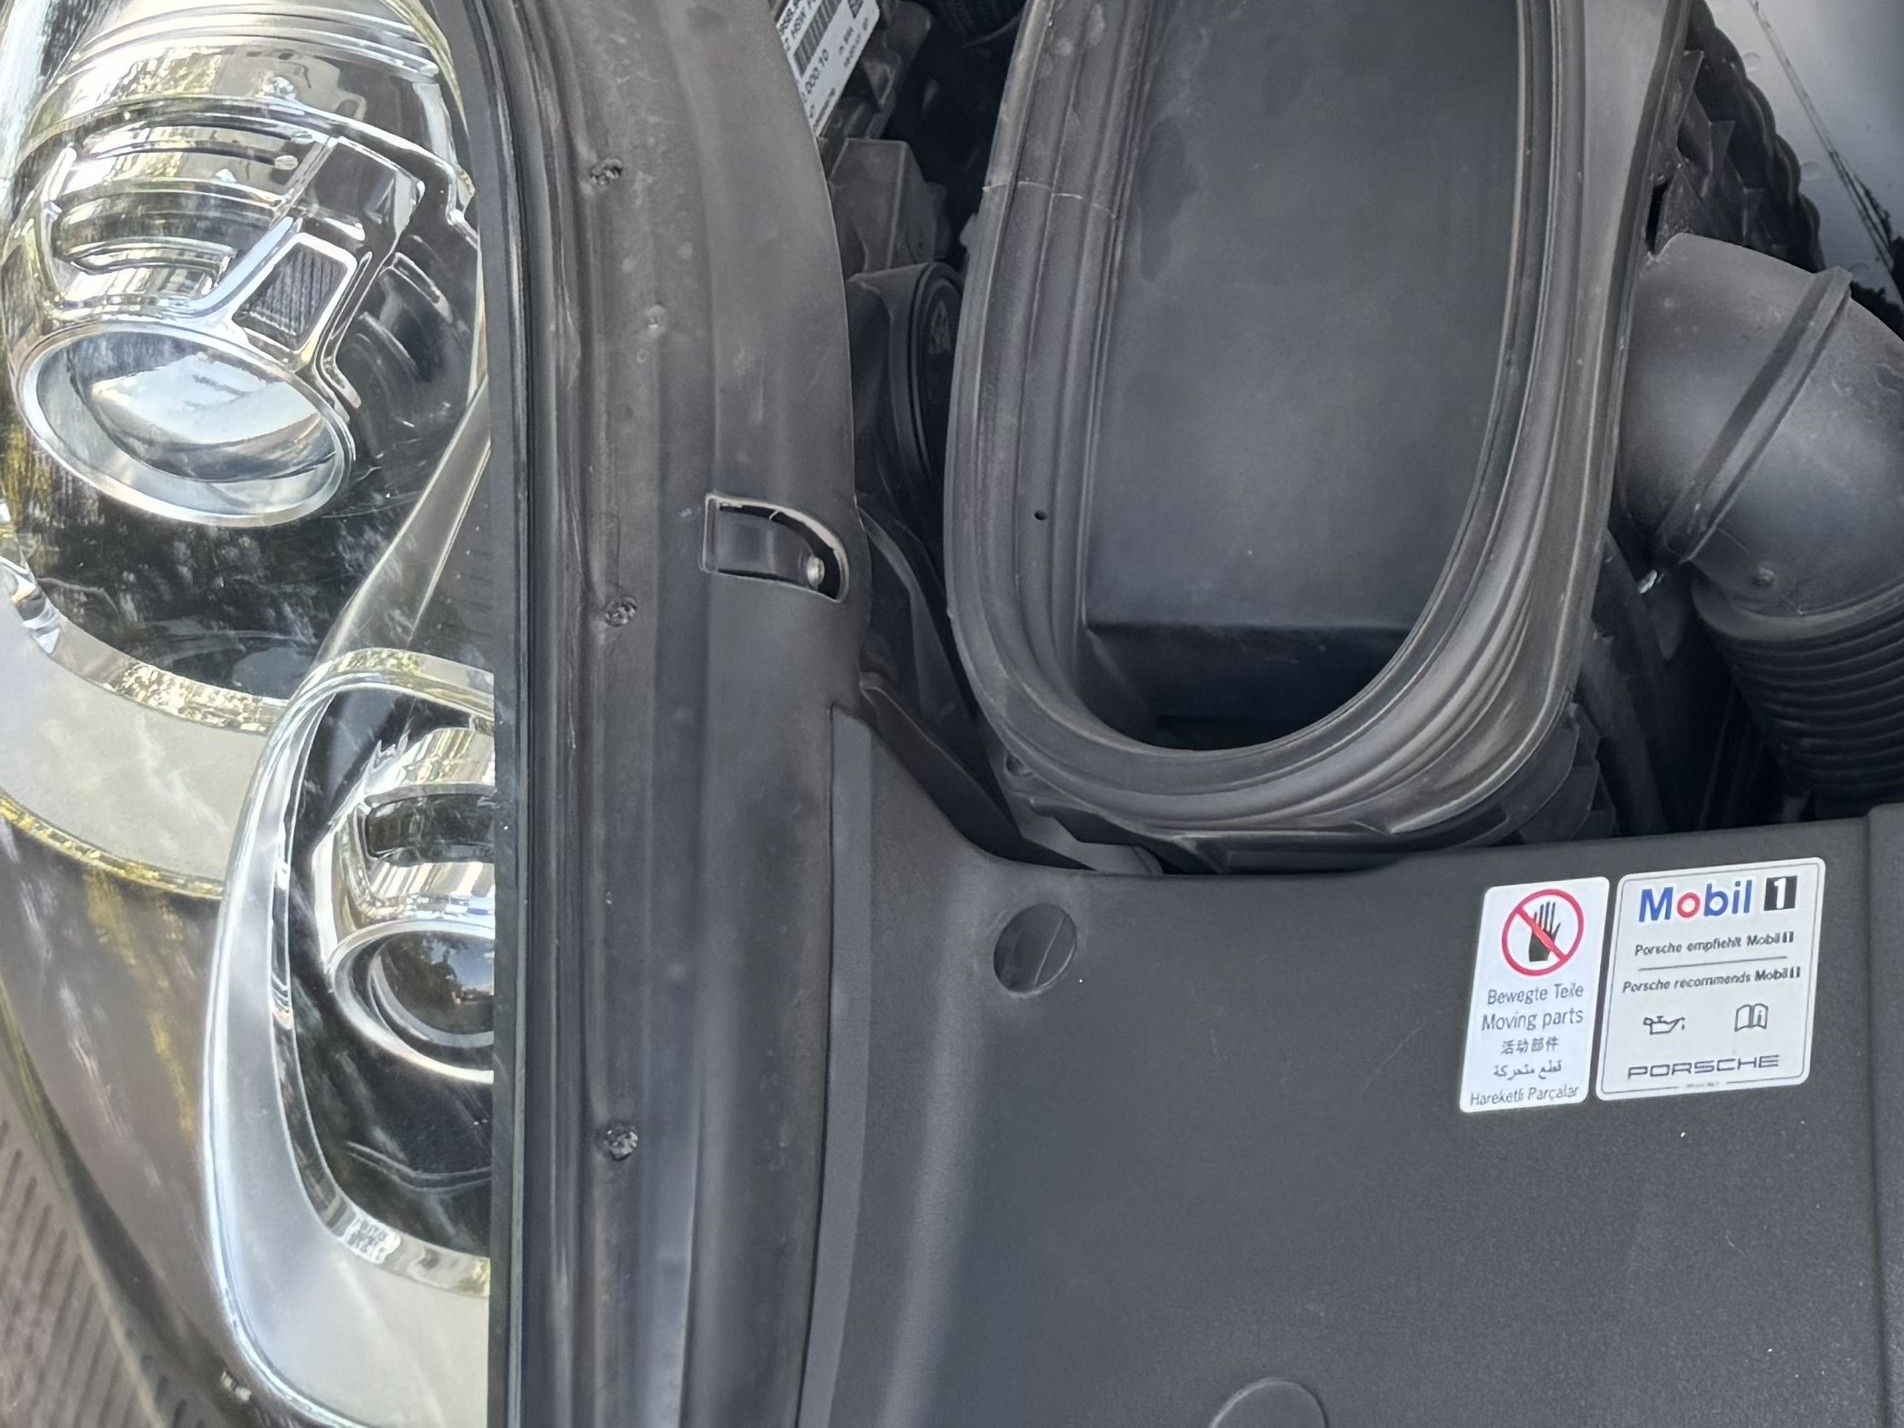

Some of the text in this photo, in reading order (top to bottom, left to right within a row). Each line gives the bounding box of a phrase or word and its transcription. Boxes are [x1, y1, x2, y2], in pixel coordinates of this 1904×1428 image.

[1638, 879, 1752, 922] Mobil
[1635, 944, 1682, 956] Porsche
[1747, 933, 1780, 946] Mobil
[1623, 981, 1670, 993] Porsche
[1674, 973, 1751, 988] recommends
[1755, 968, 1788, 982] Mobil
[1487, 988, 1548, 1005] Bewegte
[1482, 1009, 1584, 1031] Moving parts
[1627, 1055, 1780, 1079] PORSCHE
[1528, 1084, 1580, 1102] Parçalar
